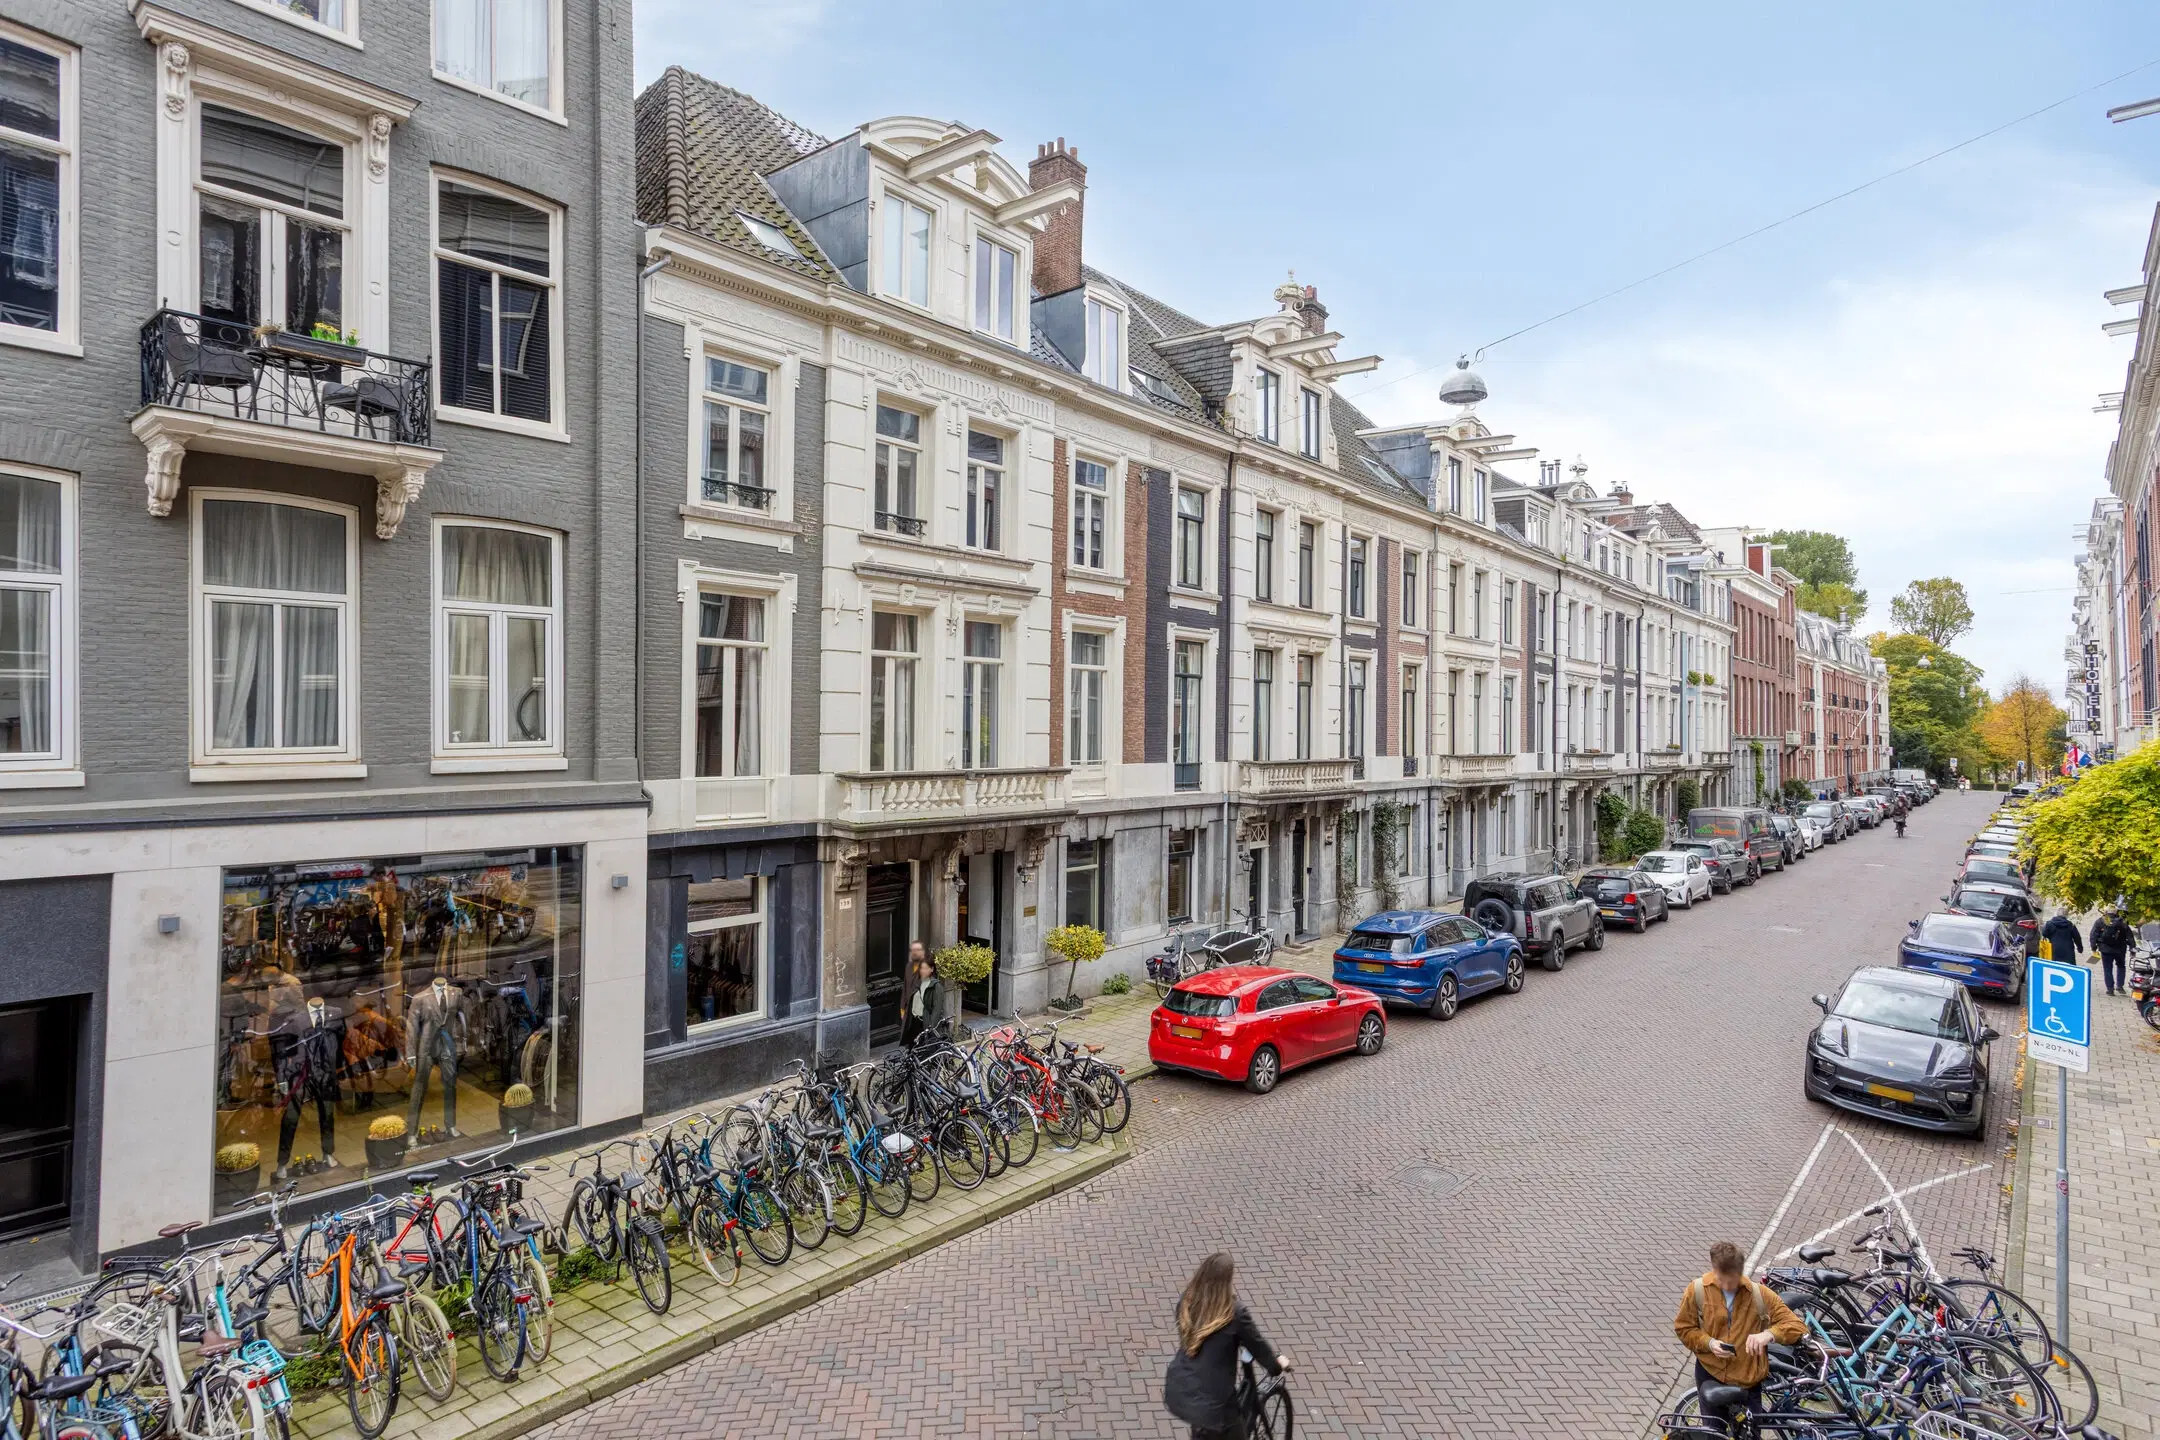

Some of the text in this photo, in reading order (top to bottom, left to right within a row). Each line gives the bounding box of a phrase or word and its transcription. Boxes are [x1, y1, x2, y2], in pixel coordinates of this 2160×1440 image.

[2086, 656, 2099, 718] HOTEL
[2042, 966, 2074, 1004] P
[2033, 1039, 2081, 1057] N-207-NL
